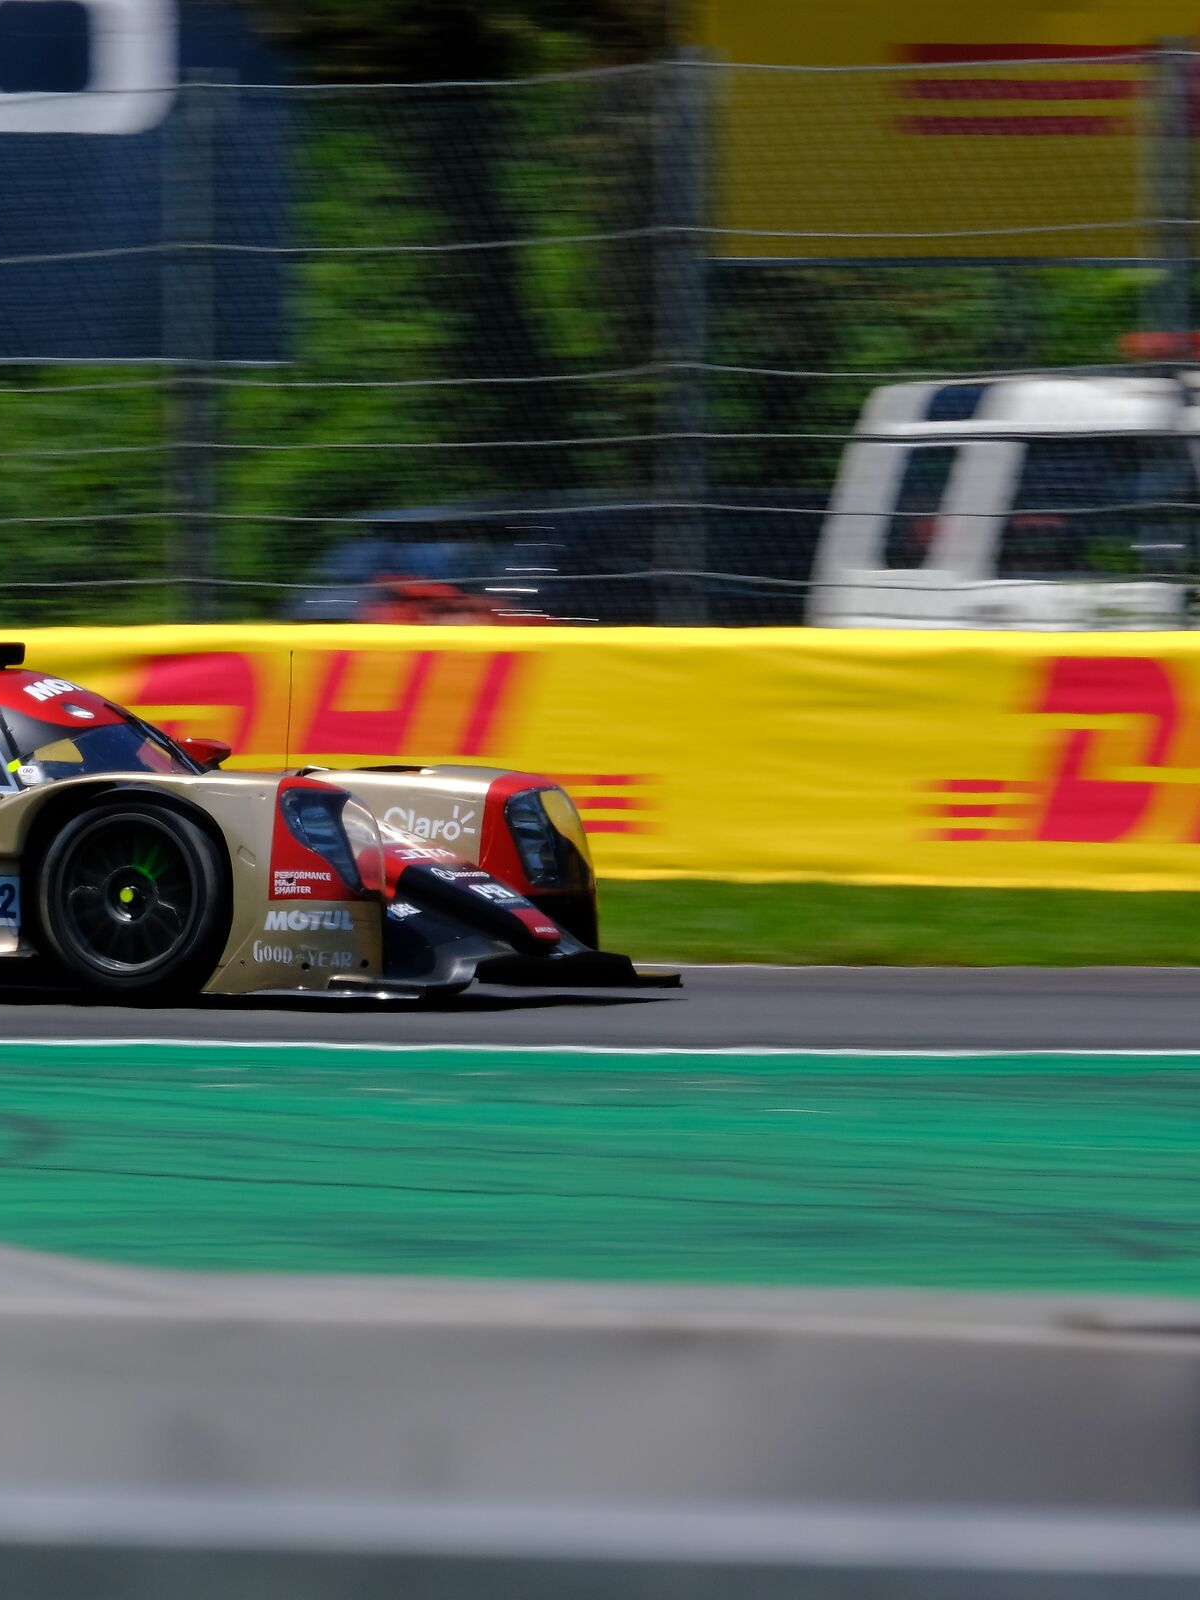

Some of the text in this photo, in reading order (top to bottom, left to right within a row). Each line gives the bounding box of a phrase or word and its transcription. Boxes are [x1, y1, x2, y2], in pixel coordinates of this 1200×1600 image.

[383, 806, 462, 841] Claro
[274, 871, 332, 881] PERFORMANCE
[274, 885, 312, 895] SMARTER
[263, 910, 354, 931] MOTUL
[253, 940, 294, 964] GOOD
